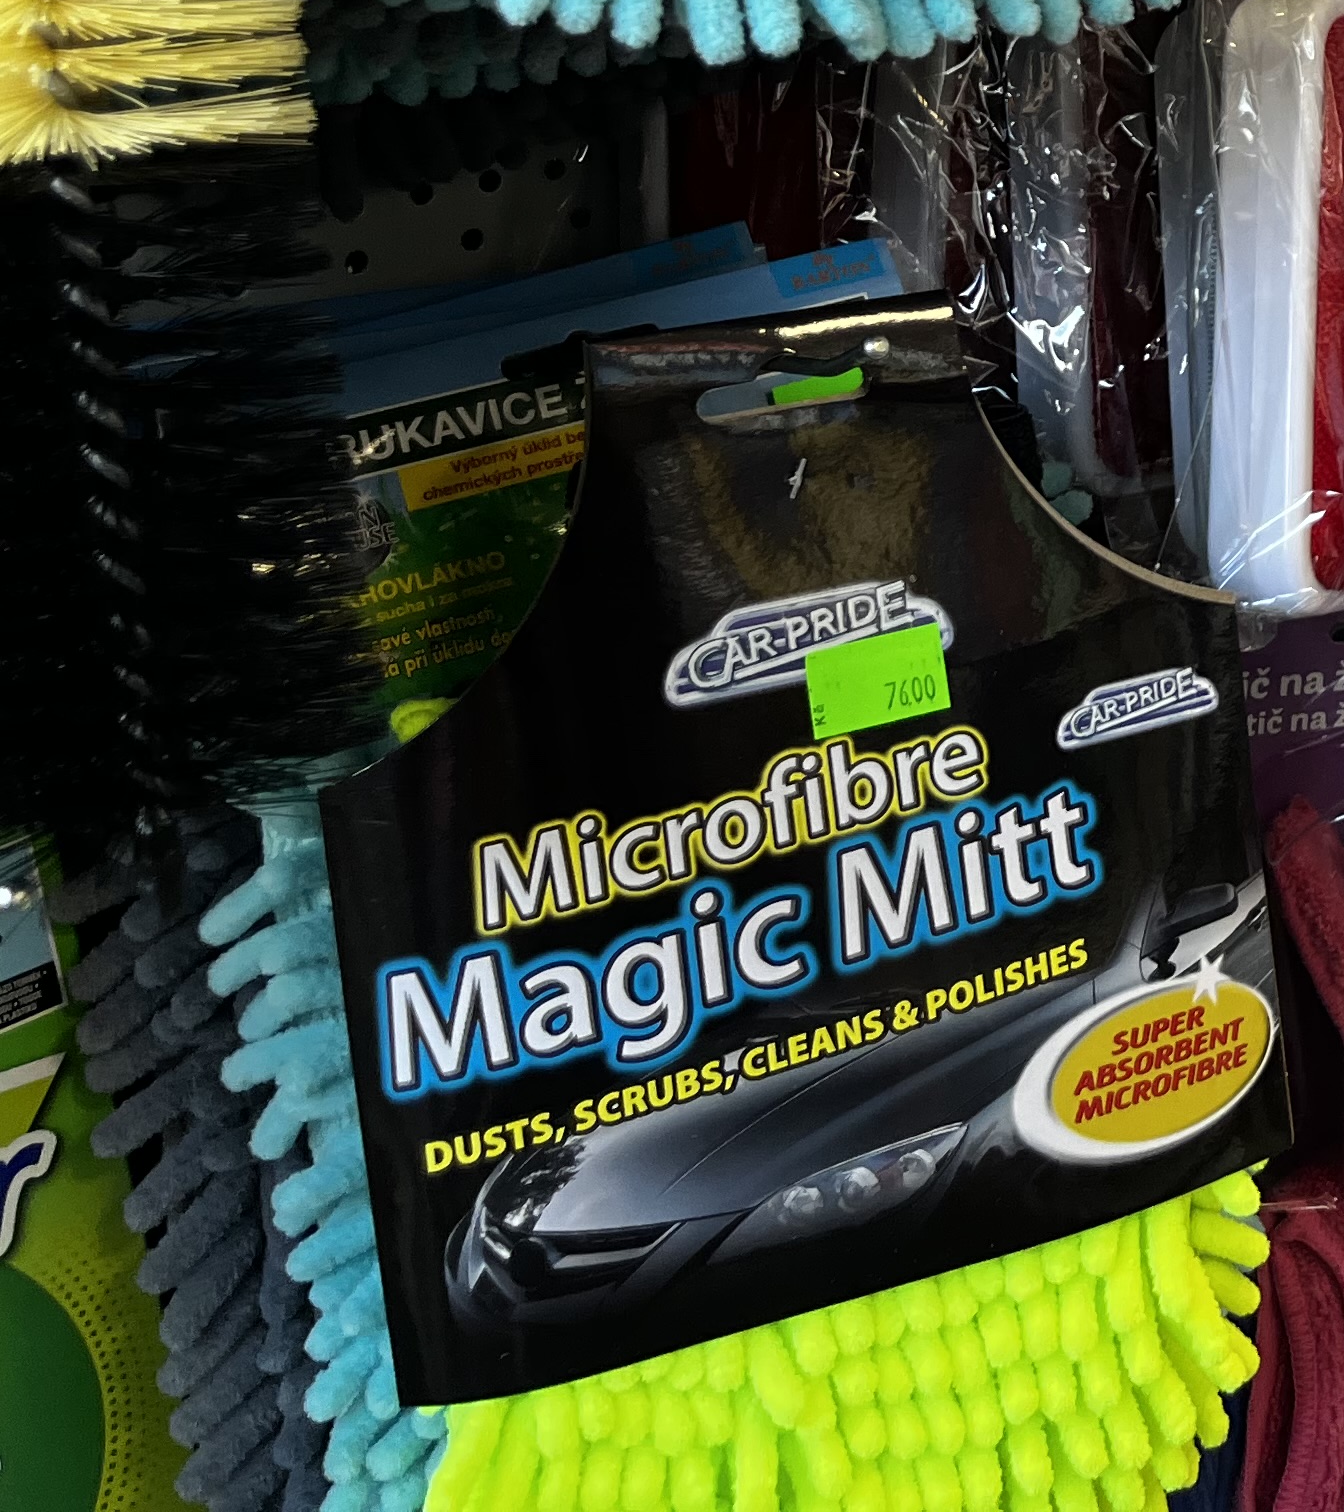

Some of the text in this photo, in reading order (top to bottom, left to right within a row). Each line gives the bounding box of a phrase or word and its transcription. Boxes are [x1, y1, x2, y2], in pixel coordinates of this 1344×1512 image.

[450, 447, 517, 474] Výborný
[688, 581, 914, 688] CAR-PRIDE
[1070, 669, 1200, 738] CAR-PRIDE
[1280, 668, 1325, 697] na
[1290, 706, 1328, 732] na
[475, 729, 986, 934] Microfibre
[386, 785, 1092, 1094] Magic Mitt
[424, 939, 1089, 1175] DUSTS, SCRUBS, CLEANS & POLISHES
[1073, 1017, 1245, 1096] ABSORBENT
[1110, 1004, 1207, 1057] SUPER
[1072, 1045, 1248, 1125] MICROFIBRE
